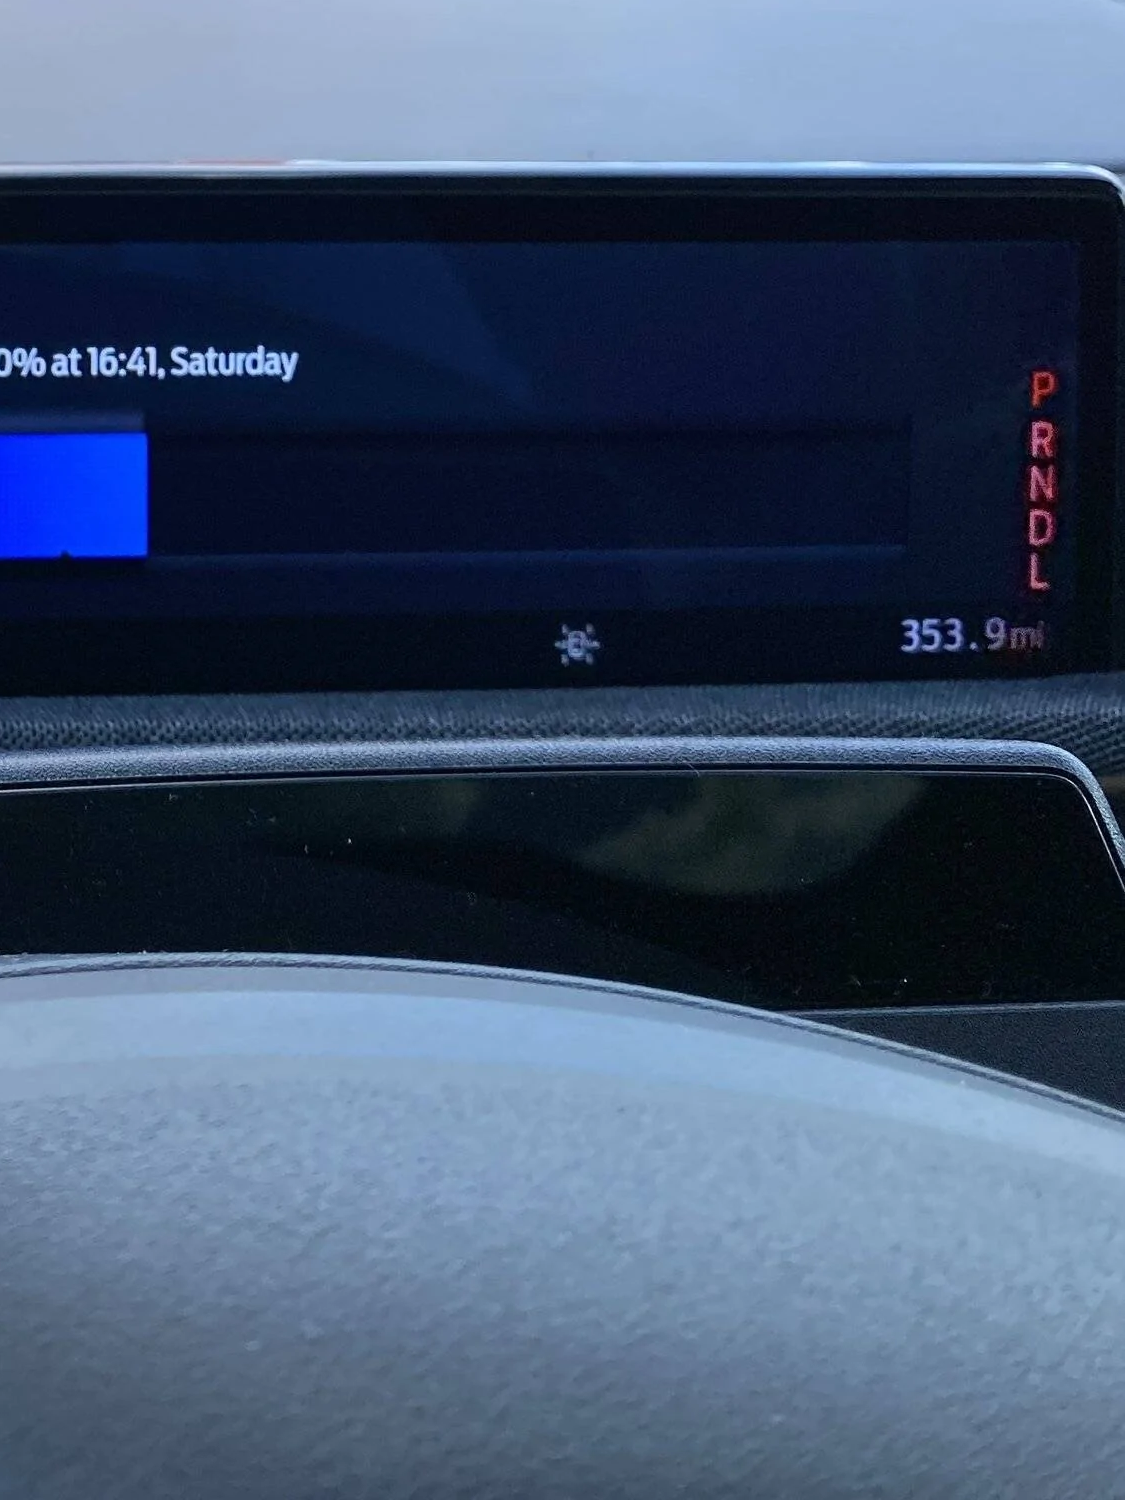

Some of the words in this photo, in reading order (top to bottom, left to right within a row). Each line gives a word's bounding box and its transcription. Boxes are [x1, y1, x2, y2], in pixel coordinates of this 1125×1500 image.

[50, 347, 83, 378] at
[86, 345, 166, 380] 16:41,
[169, 344, 300, 383] Saturday
